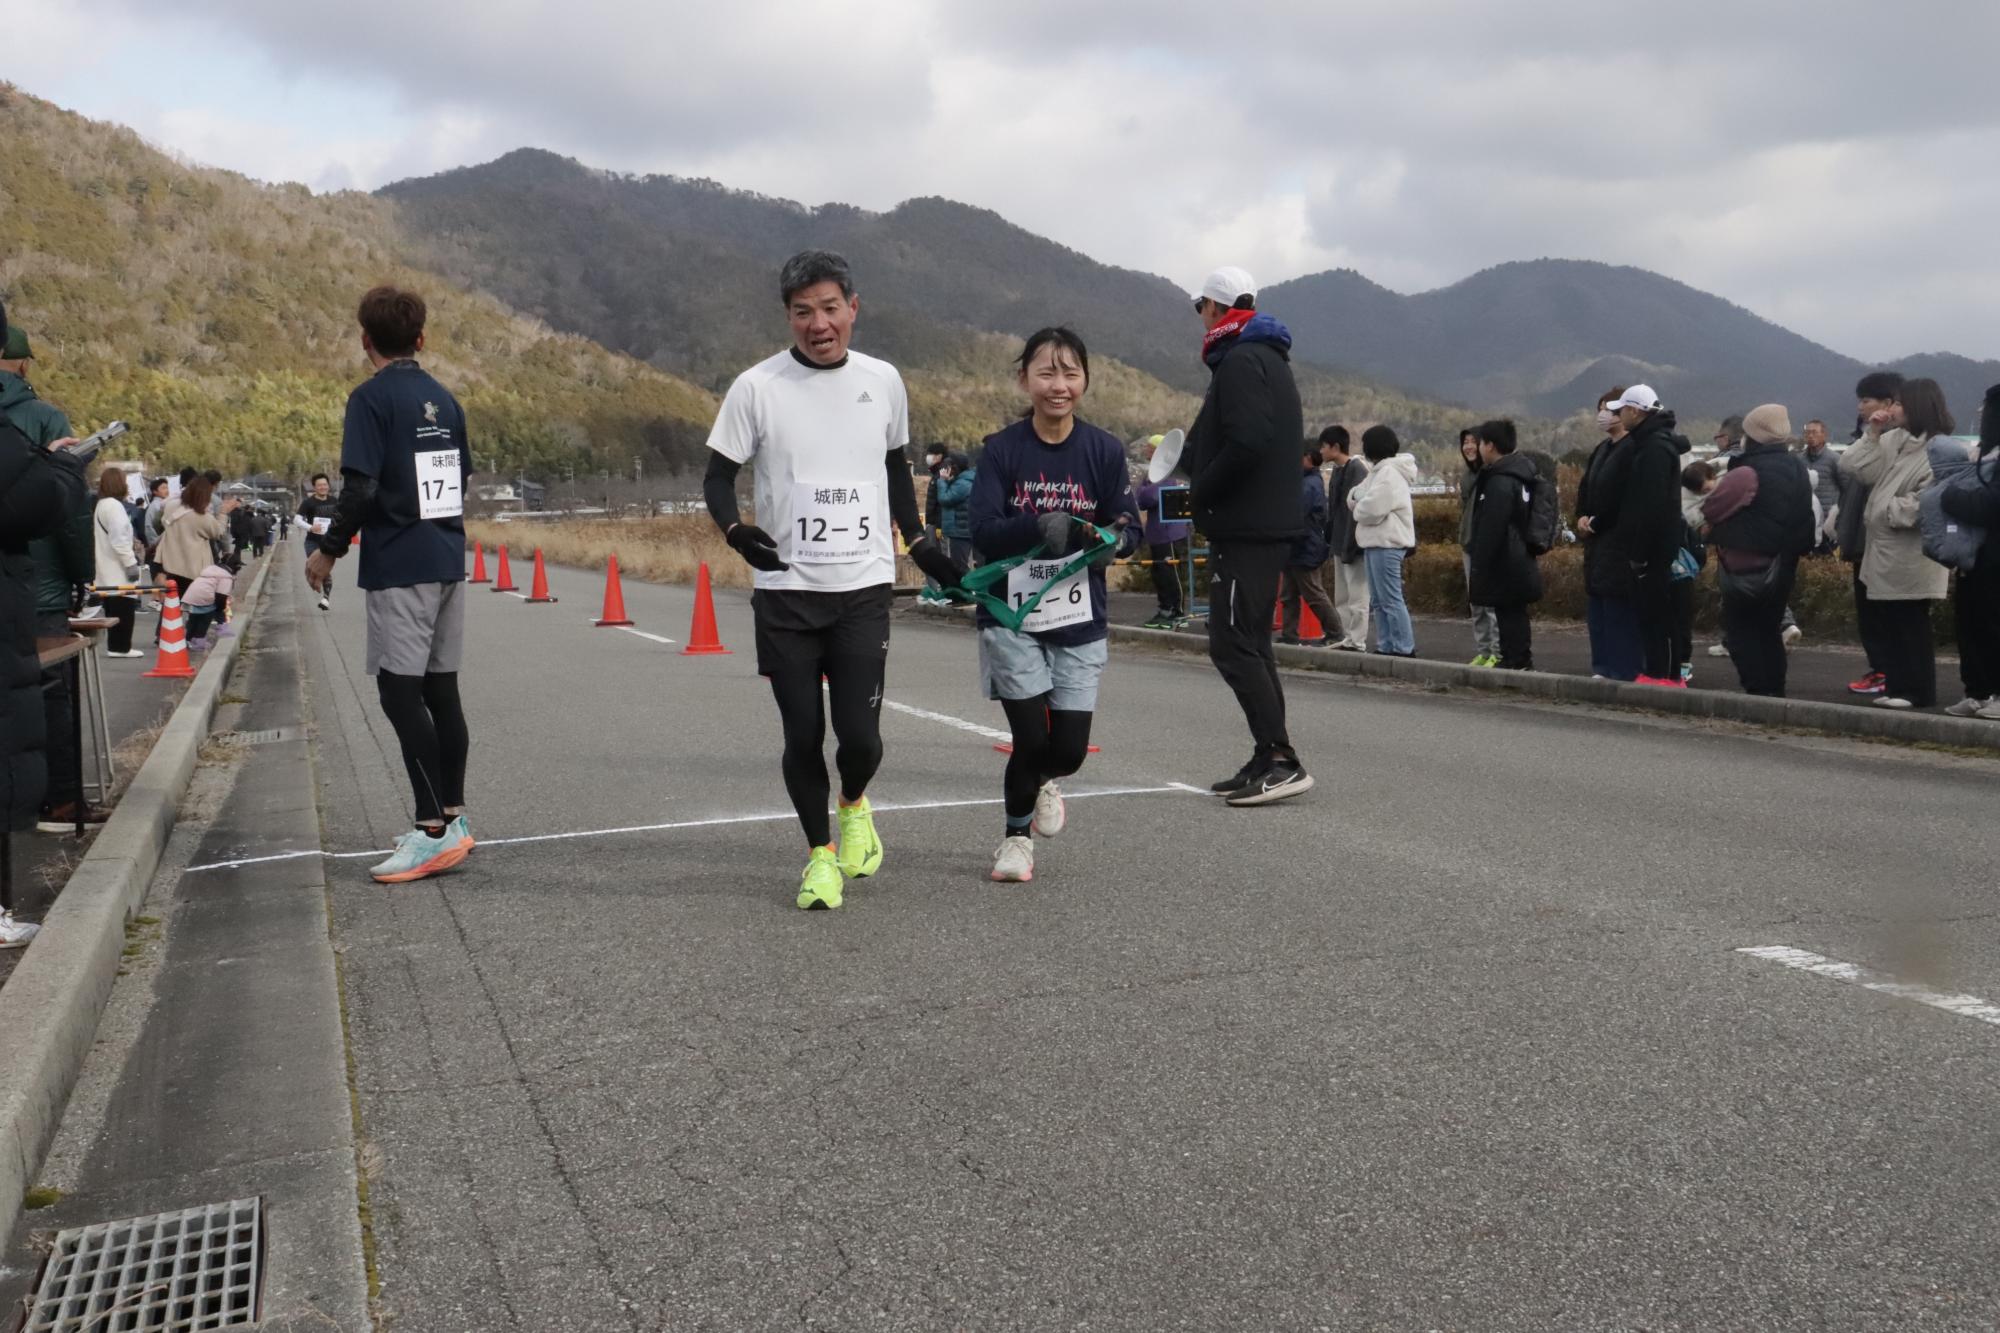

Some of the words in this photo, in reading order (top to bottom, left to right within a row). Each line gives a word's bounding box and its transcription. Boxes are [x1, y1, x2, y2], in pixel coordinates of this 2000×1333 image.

[1023, 480, 1079, 495] HIRAKATA
[813, 487, 861, 505] 城南A
[1036, 498, 1098, 511] MARATHON
[1029, 562, 1069, 580] 城南
